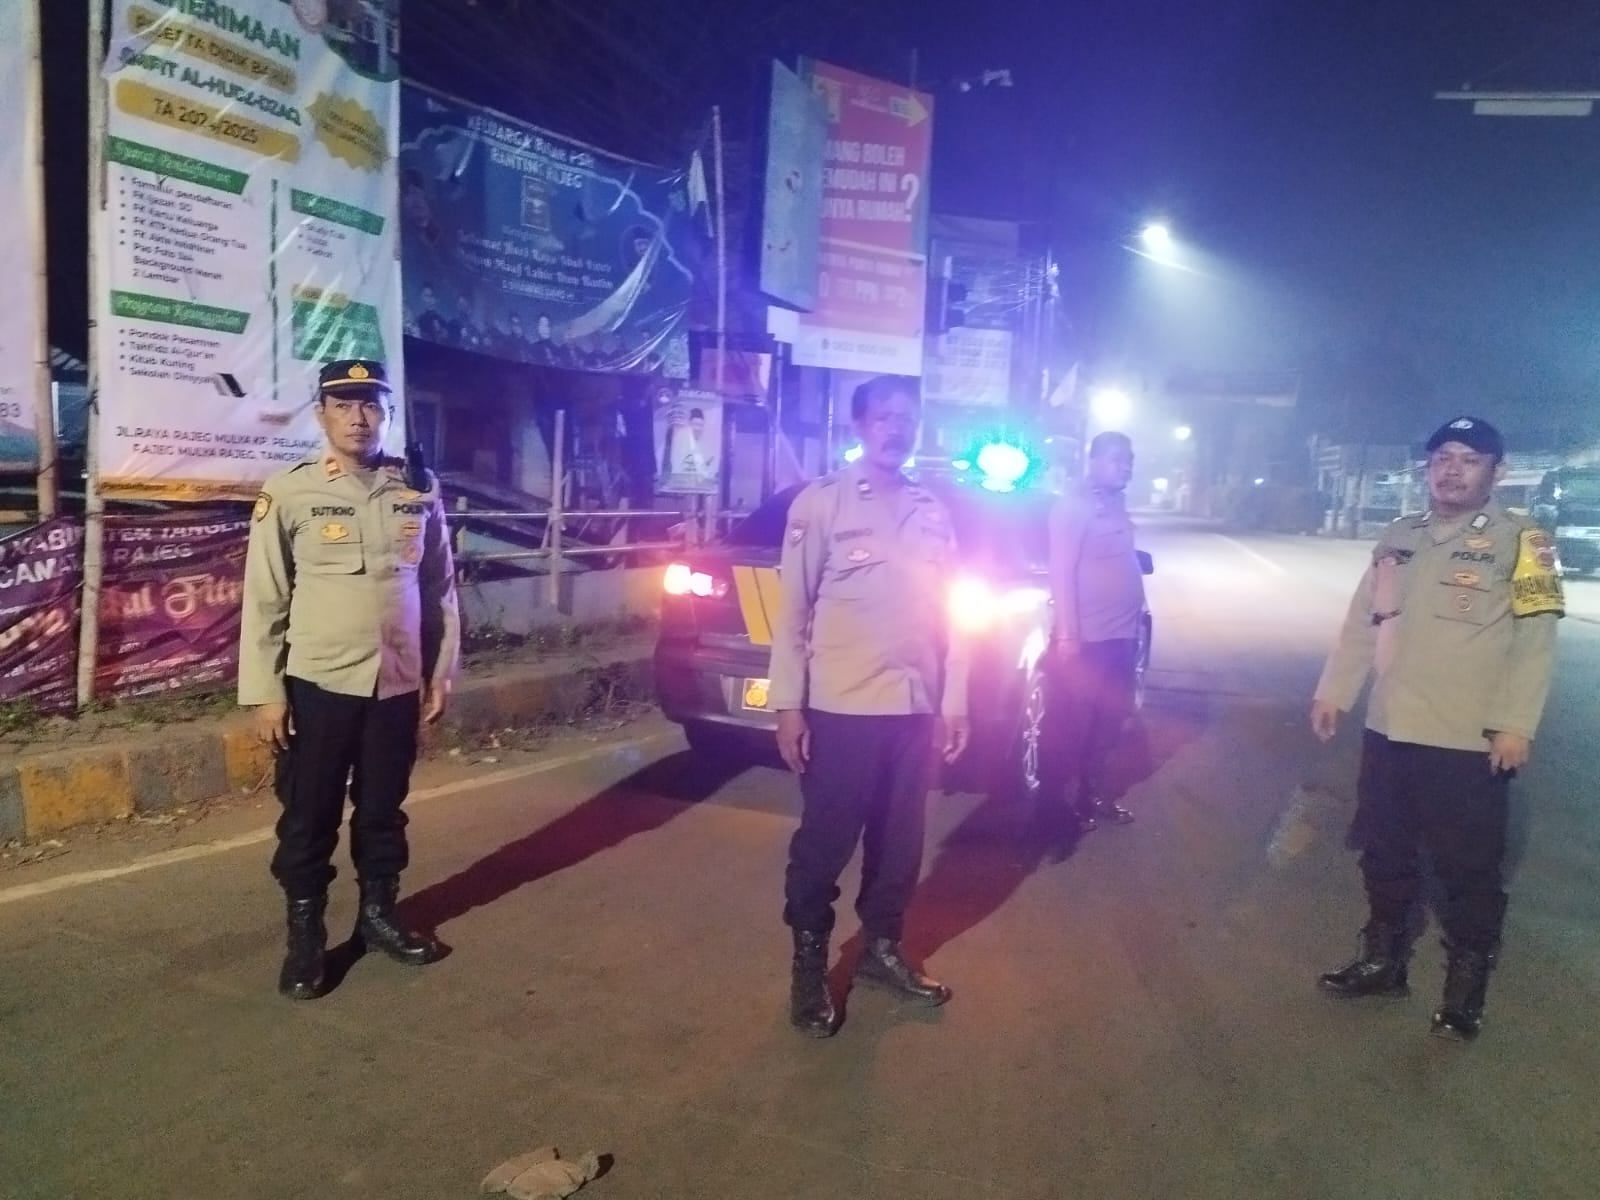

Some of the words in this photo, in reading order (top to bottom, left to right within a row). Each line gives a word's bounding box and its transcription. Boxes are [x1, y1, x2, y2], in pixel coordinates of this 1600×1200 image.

[155, 98, 174, 117] TA
[130, 354, 157, 366] Kitab
[159, 359, 195, 372] Kuning
[173, 430, 212, 443] RAJEG
[113, 543, 194, 567] RAJEG
[1450, 551, 1496, 564] POLRI
